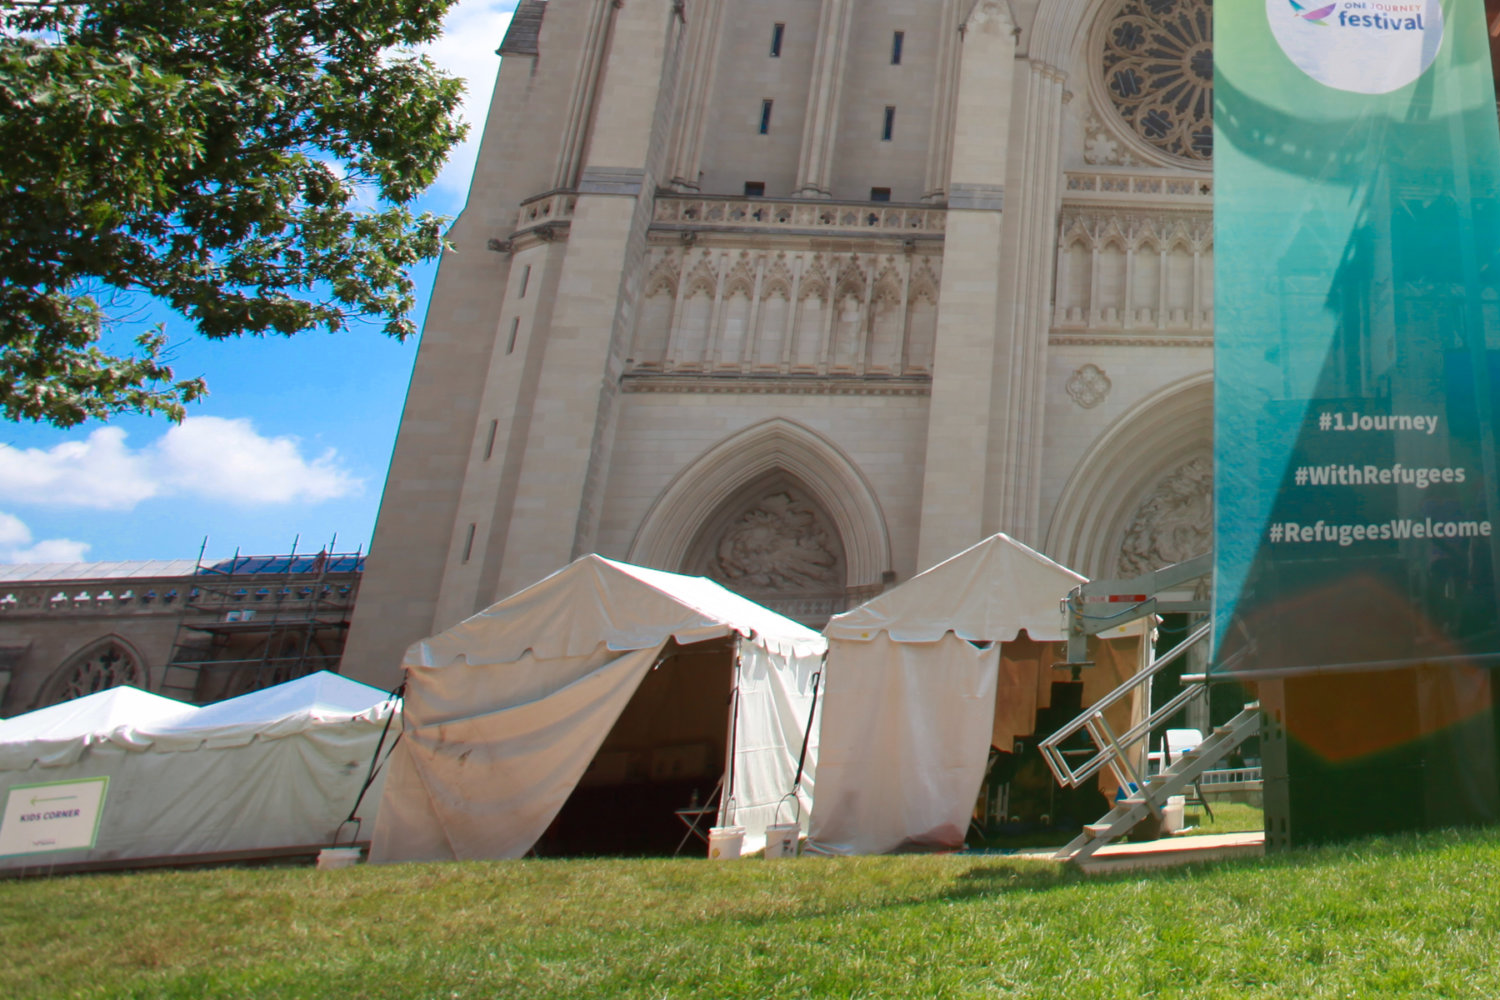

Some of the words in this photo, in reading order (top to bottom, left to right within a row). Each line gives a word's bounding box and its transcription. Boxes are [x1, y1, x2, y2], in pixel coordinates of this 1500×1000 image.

[1338, 10, 1425, 31] festival
[1319, 411, 1438, 435] #1Journey
[1295, 463, 1466, 489] #WithRefugees
[1269, 517, 1493, 547] #RefugeesWelcome
[20, 812, 42, 822] KIDS
[43, 808, 80, 820] CORNER
